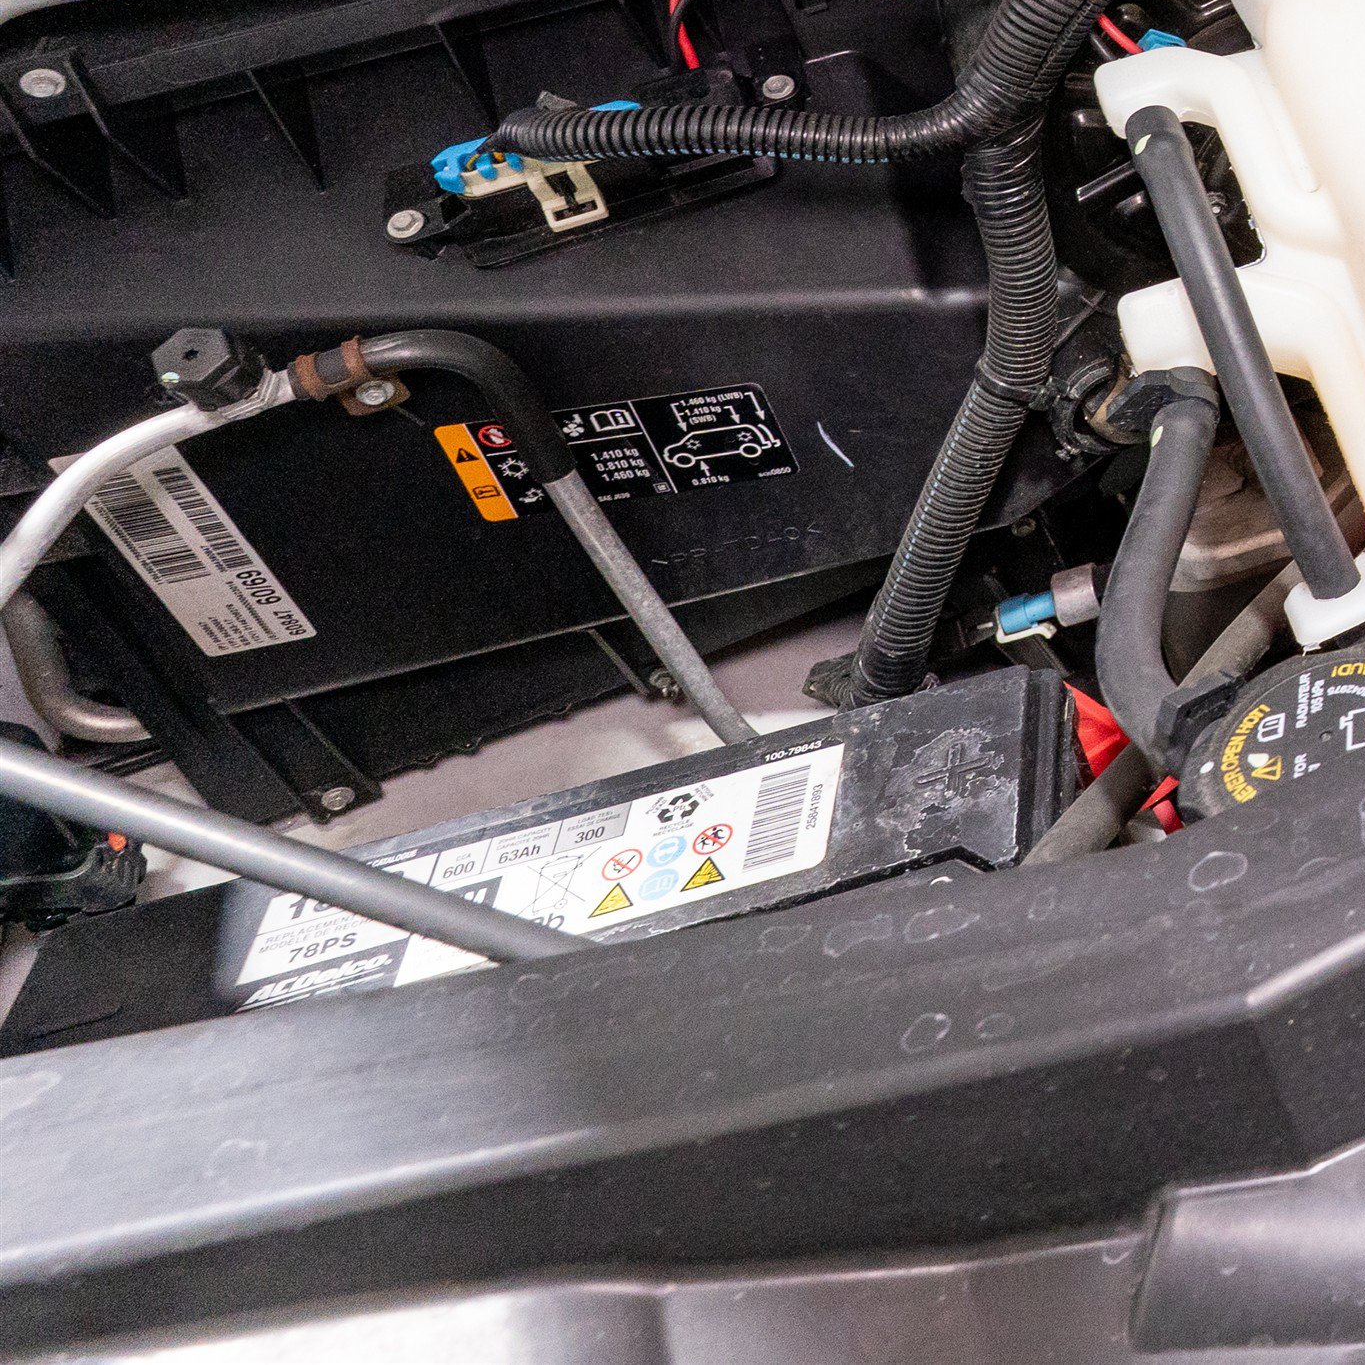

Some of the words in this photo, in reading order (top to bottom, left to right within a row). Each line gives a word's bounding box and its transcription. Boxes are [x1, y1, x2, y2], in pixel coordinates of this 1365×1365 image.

[589, 449, 624, 461] 1.410
[594, 459, 630, 471] 0.810
[600, 469, 635, 482] 1.460
[233, 568, 283, 606] 60/69
[272, 608, 308, 636] 60847
[1295, 672, 1312, 729] RADIATEUR
[763, 739, 822, 762] 100-79843
[1220, 734, 1248, 772] OPEN
[573, 825, 605, 844] 300
[497, 842, 541, 865] 63Ah
[442, 859, 475, 879] 600
[288, 931, 358, 963] 78PS
